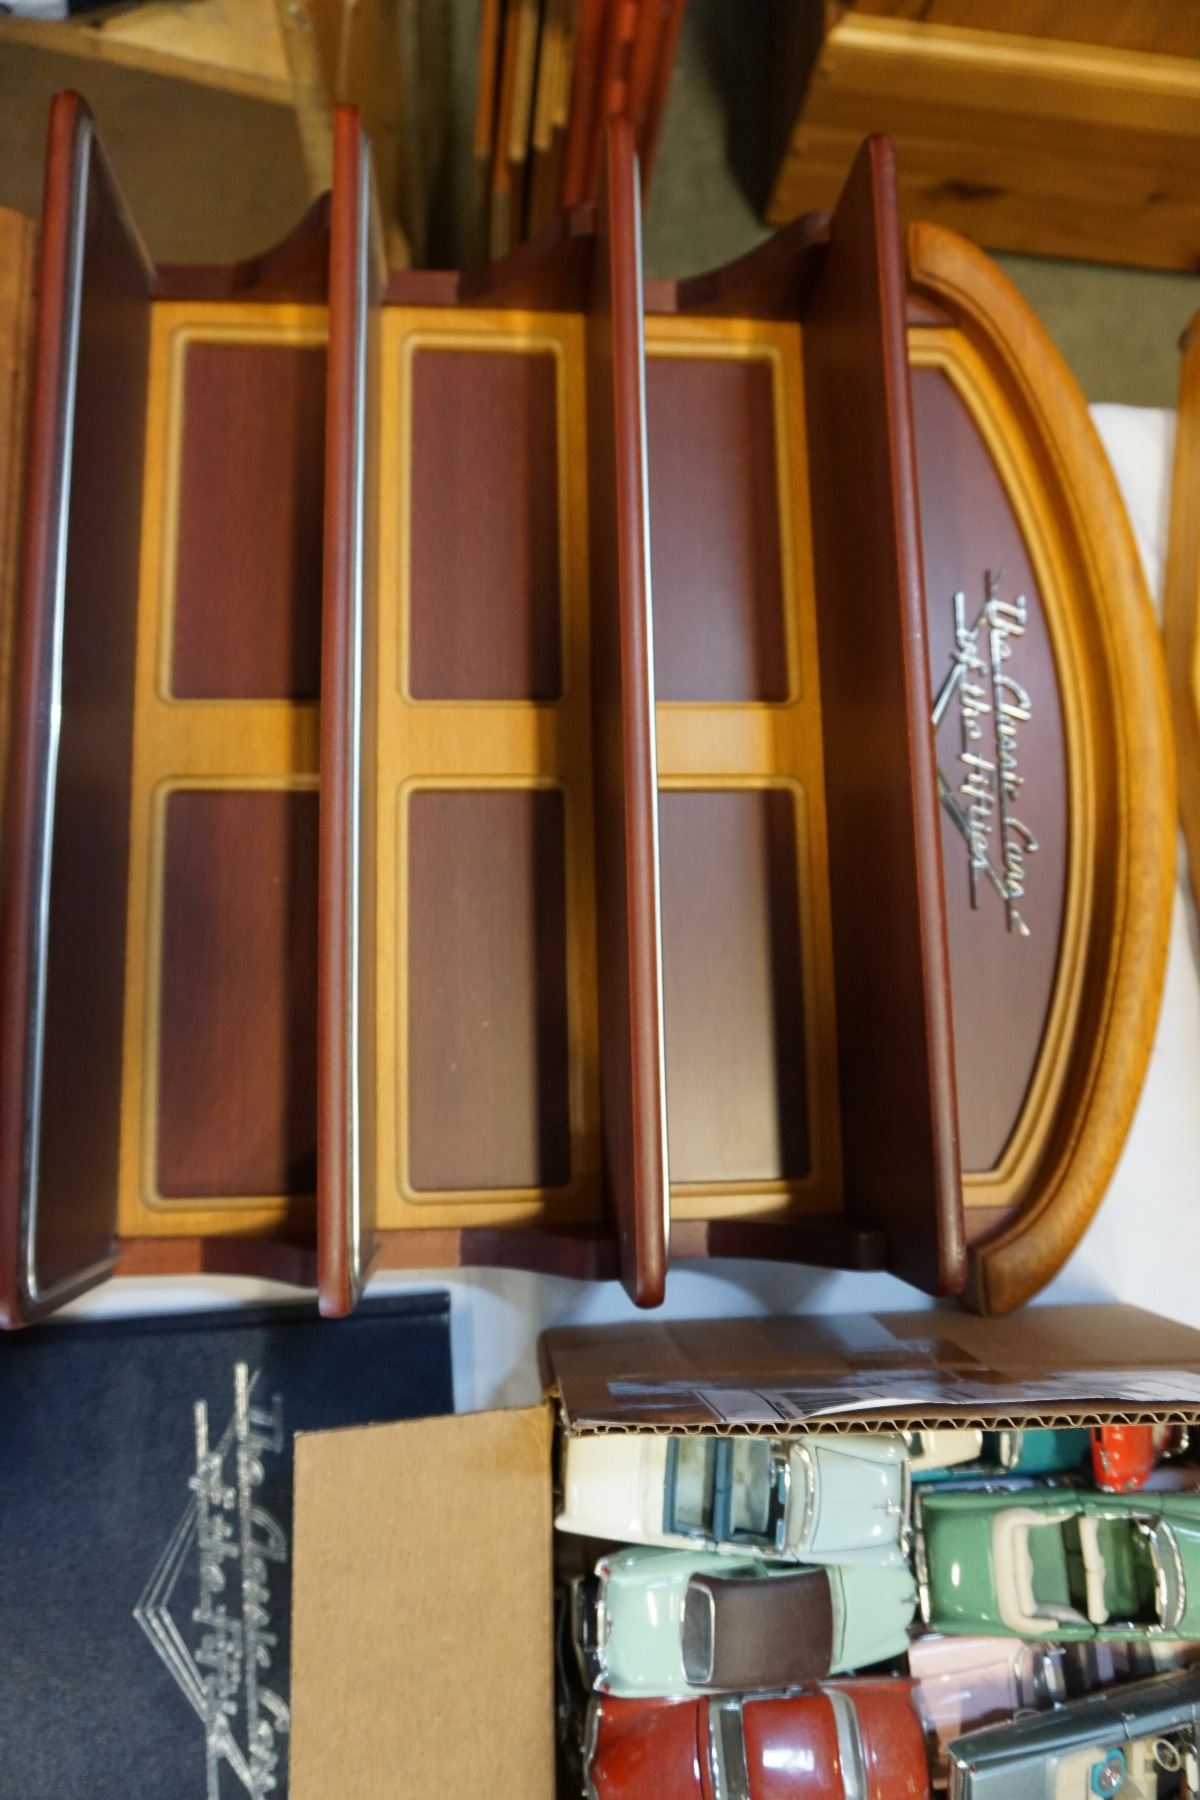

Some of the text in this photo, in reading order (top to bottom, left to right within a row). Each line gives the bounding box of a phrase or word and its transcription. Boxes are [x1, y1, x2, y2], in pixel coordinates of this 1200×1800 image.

[952, 629, 996, 870] of the Fifties
[987, 595, 1039, 899] The Classic Cars
[189, 1454, 235, 1509] of
[200, 1513, 239, 1593] the
[240, 1393, 290, 1792] The Classic Cars
